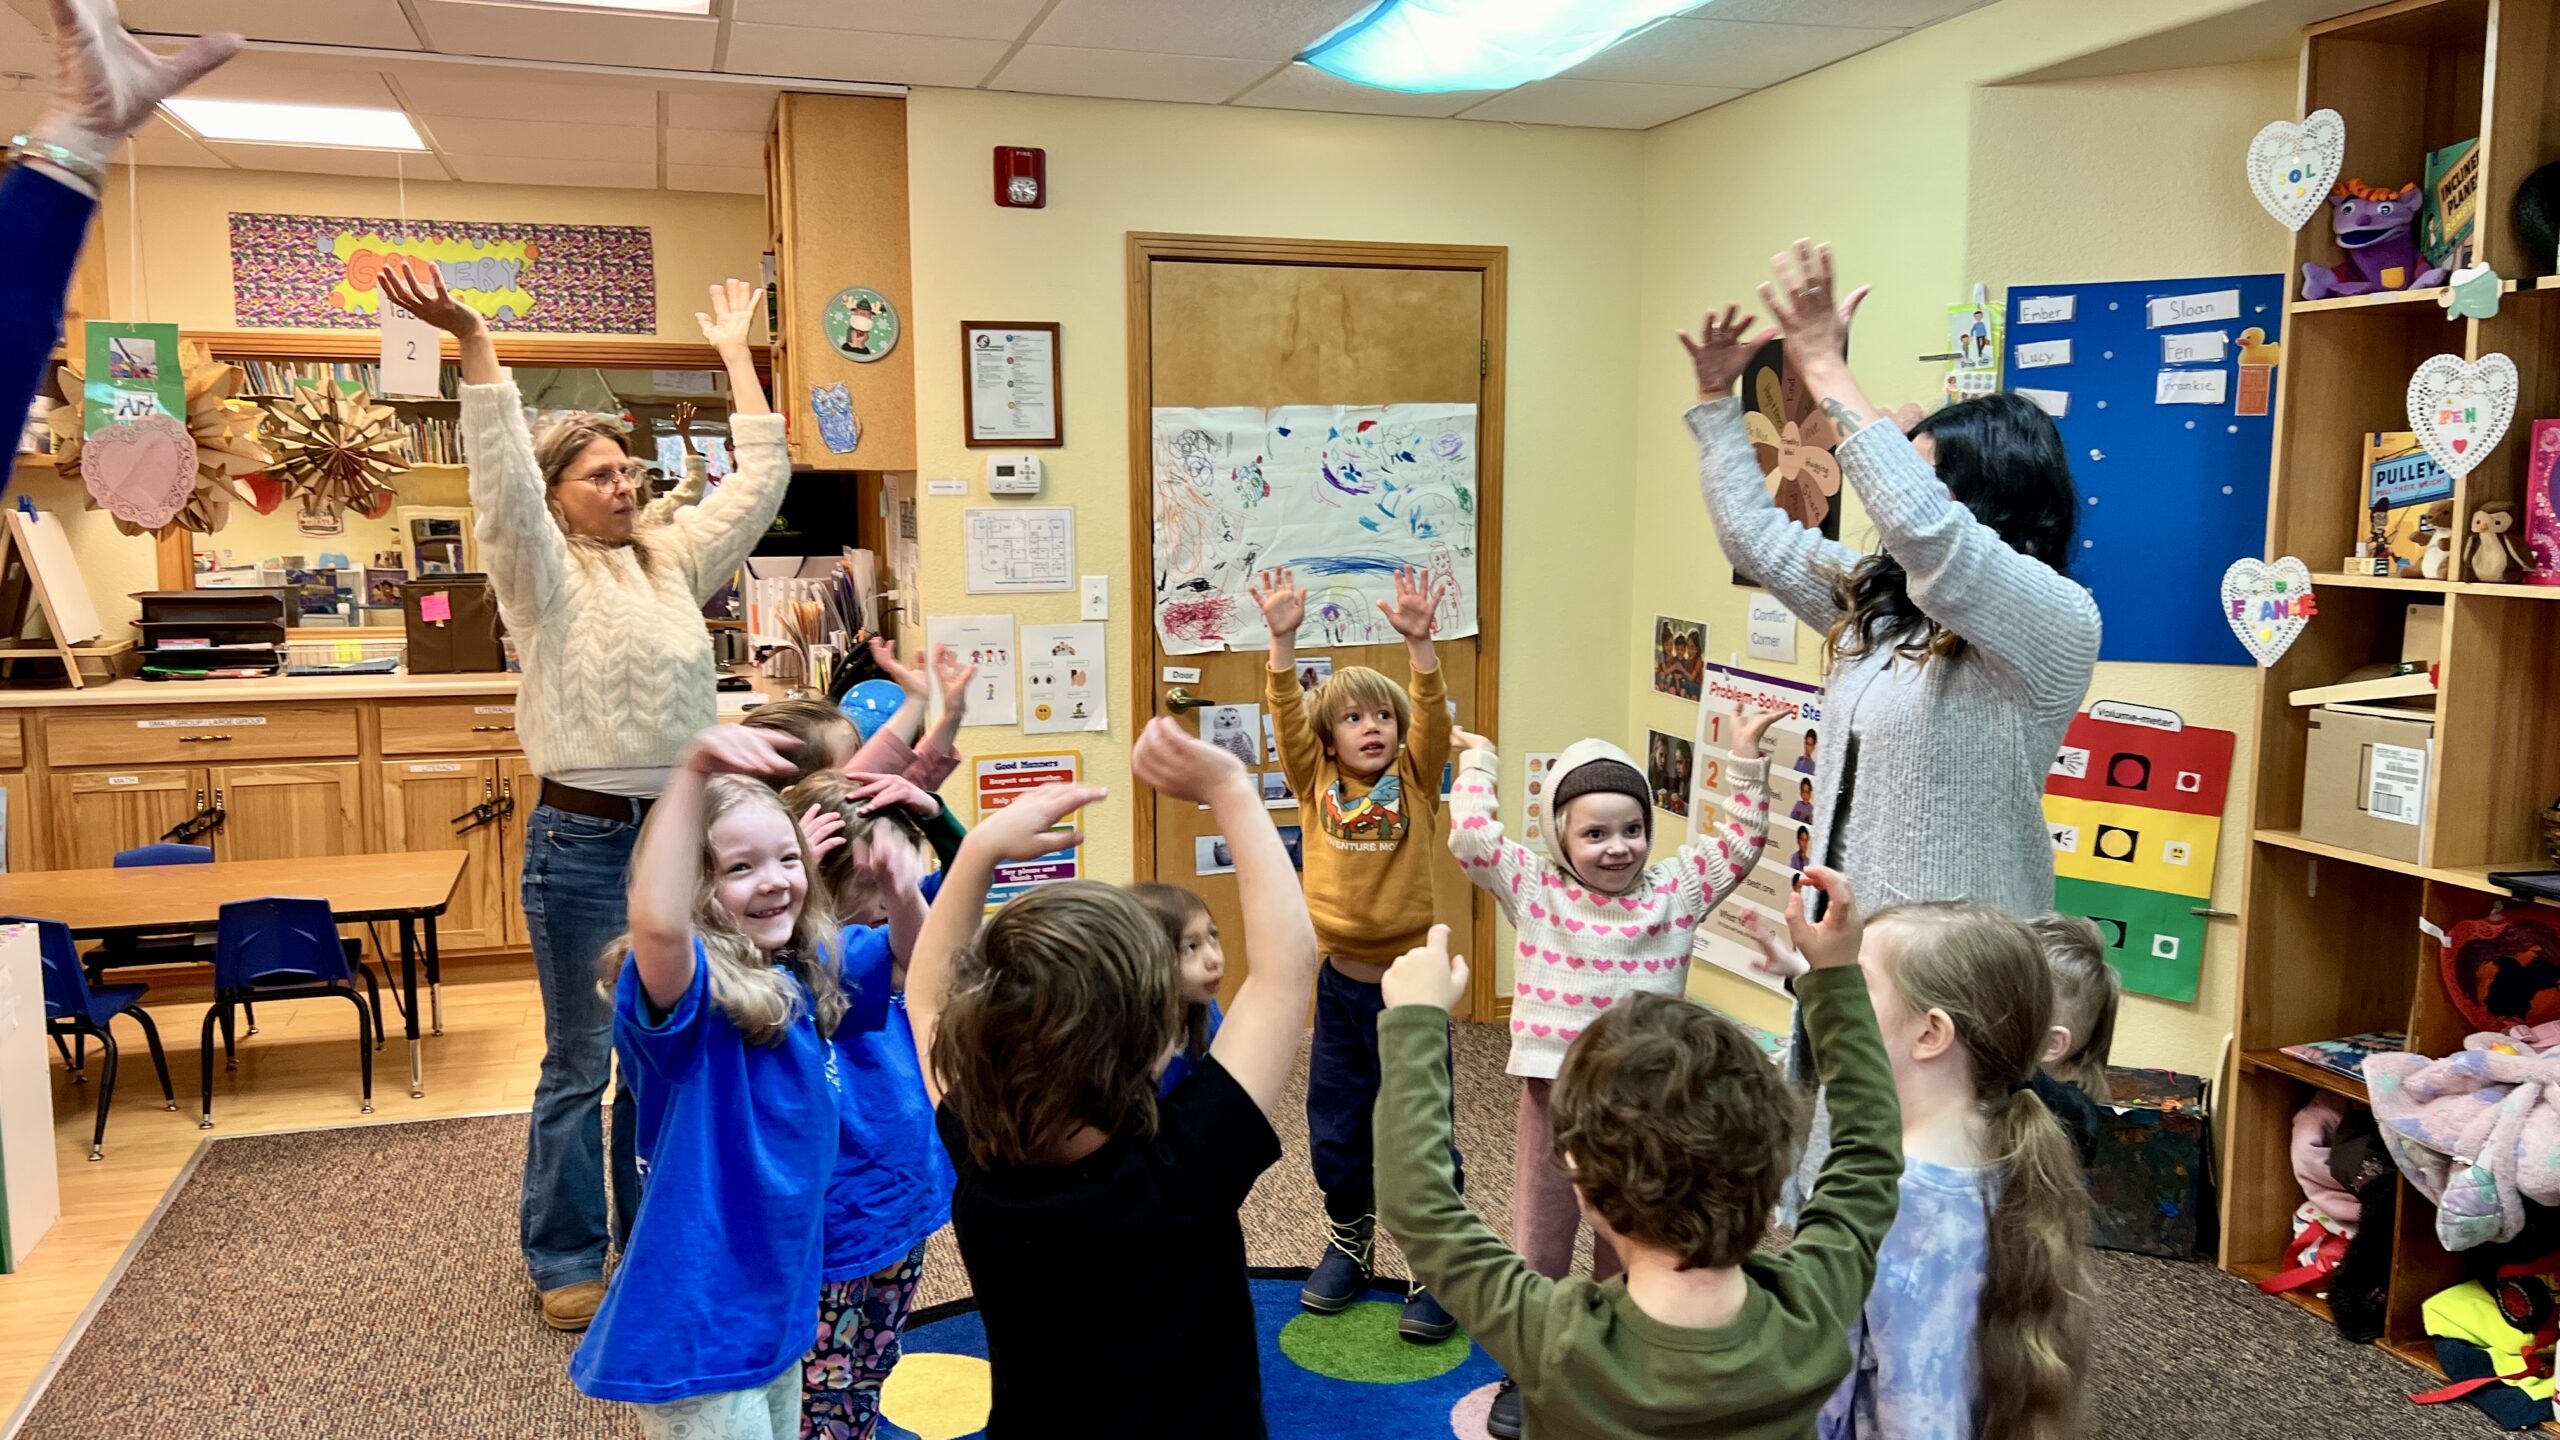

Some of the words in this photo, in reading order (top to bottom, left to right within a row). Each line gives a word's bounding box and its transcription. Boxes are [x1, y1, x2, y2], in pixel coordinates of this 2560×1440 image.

[2279, 164, 2316, 185] SOL
[2022, 307, 2063, 322] Ember
[2169, 300, 2215, 320] Sloan
[406, 341, 417, 361] 2
[2020, 351, 2056, 366] Lucy
[2166, 338, 2194, 360] Fen
[118, 394, 155, 417] Art
[1753, 608, 1787, 623] Conflict
[1751, 632, 1781, 647] Corner
[1172, 671, 1194, 679] Door
[1709, 681, 1798, 720] Problem-Solving
[2096, 708, 2174, 727] Volume-meter
[1711, 716, 1720, 742] 1
[994, 762, 1018, 771] Good
[1020, 760, 1058, 769] Manners
[1706, 760, 1718, 788] 2
[1703, 805, 1717, 833] 3
[1018, 867, 1041, 876] please
